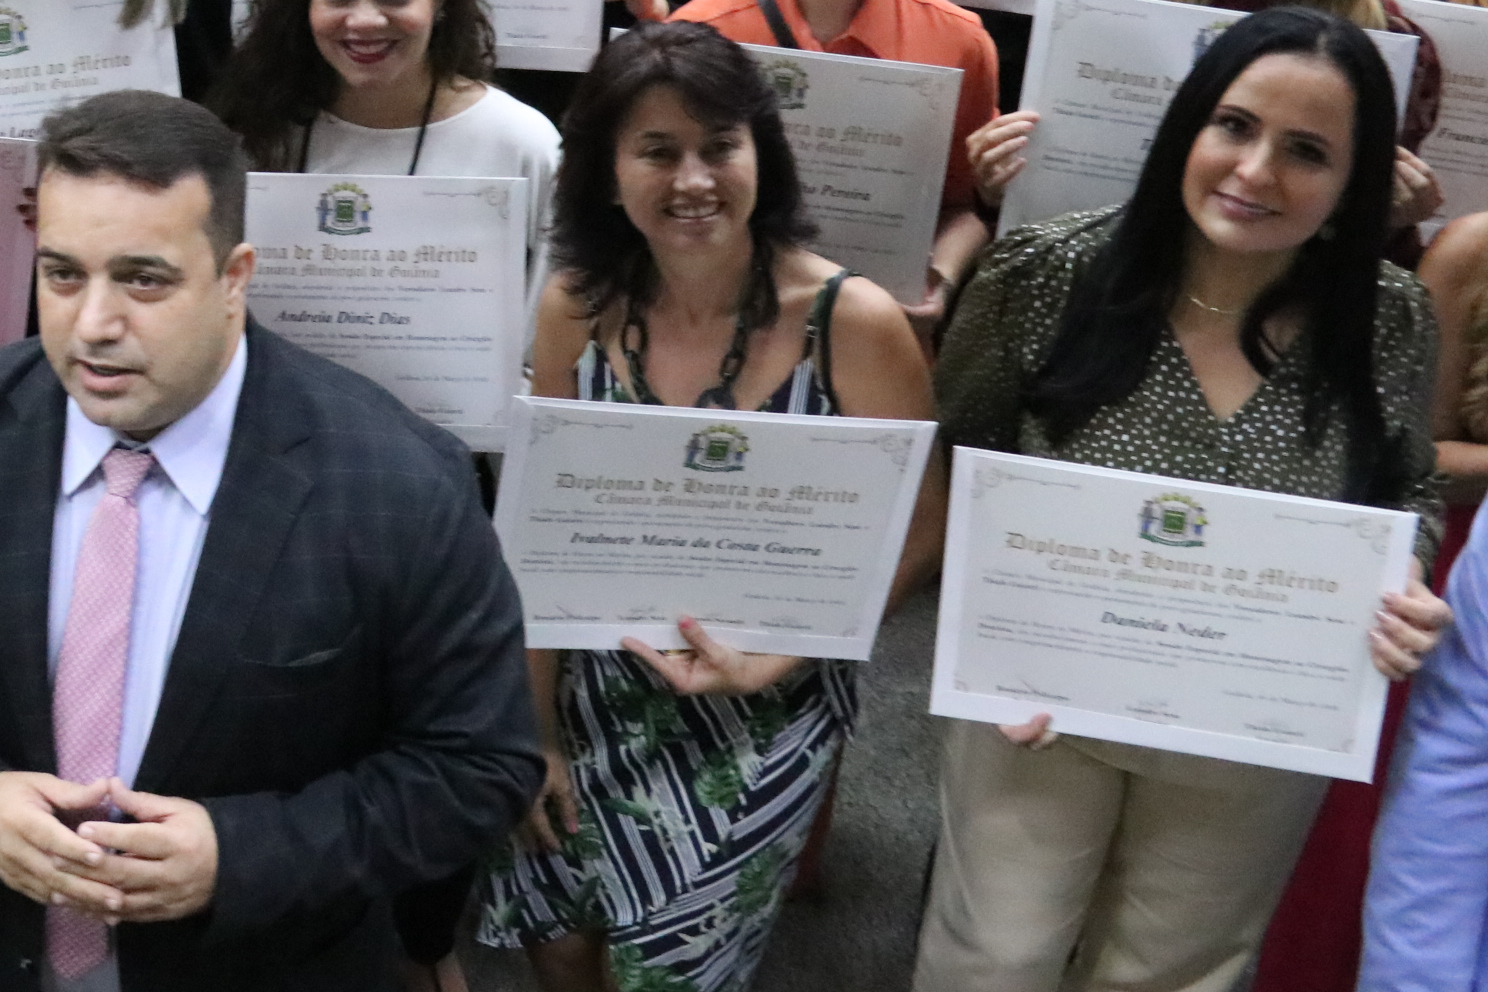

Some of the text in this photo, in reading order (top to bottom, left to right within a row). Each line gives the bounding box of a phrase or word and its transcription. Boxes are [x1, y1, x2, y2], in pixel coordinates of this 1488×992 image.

[294, 244, 314, 260] de
[321, 244, 380, 262] Honra
[412, 244, 479, 264] Mérito
[337, 311, 376, 326] Diniz
[379, 311, 411, 325] Dias
[555, 473, 860, 505] Diploma de Honra ao Mérito
[641, 533, 688, 548] Maria
[691, 536, 711, 550] da
[715, 537, 761, 552] Costa
[764, 540, 822, 556] Guerra
[1004, 530, 1340, 594] Diploma de Honra ao Mérito
[1100, 610, 1228, 641] Daniela Neder
